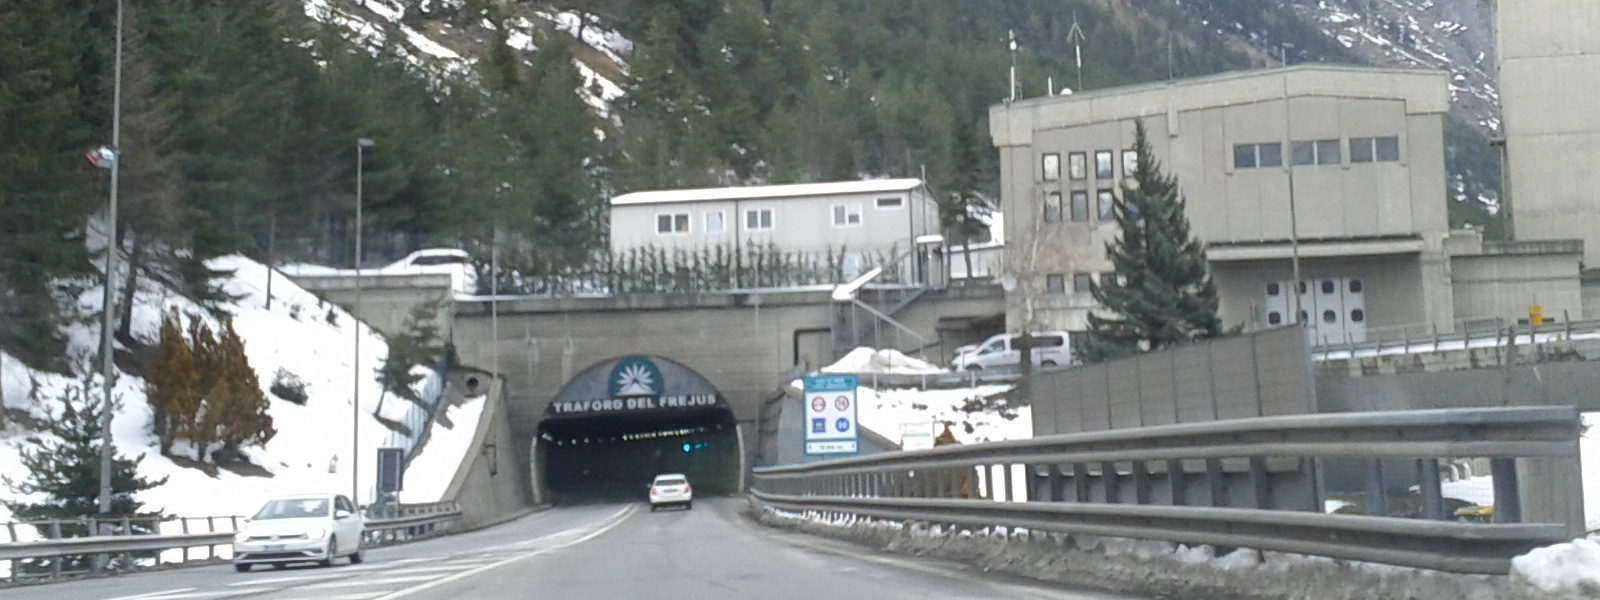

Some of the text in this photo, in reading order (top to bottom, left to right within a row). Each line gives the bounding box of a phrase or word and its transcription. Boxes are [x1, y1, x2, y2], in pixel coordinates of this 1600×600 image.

[553, 394, 716, 413] TRAFORO DEL FREJUS
